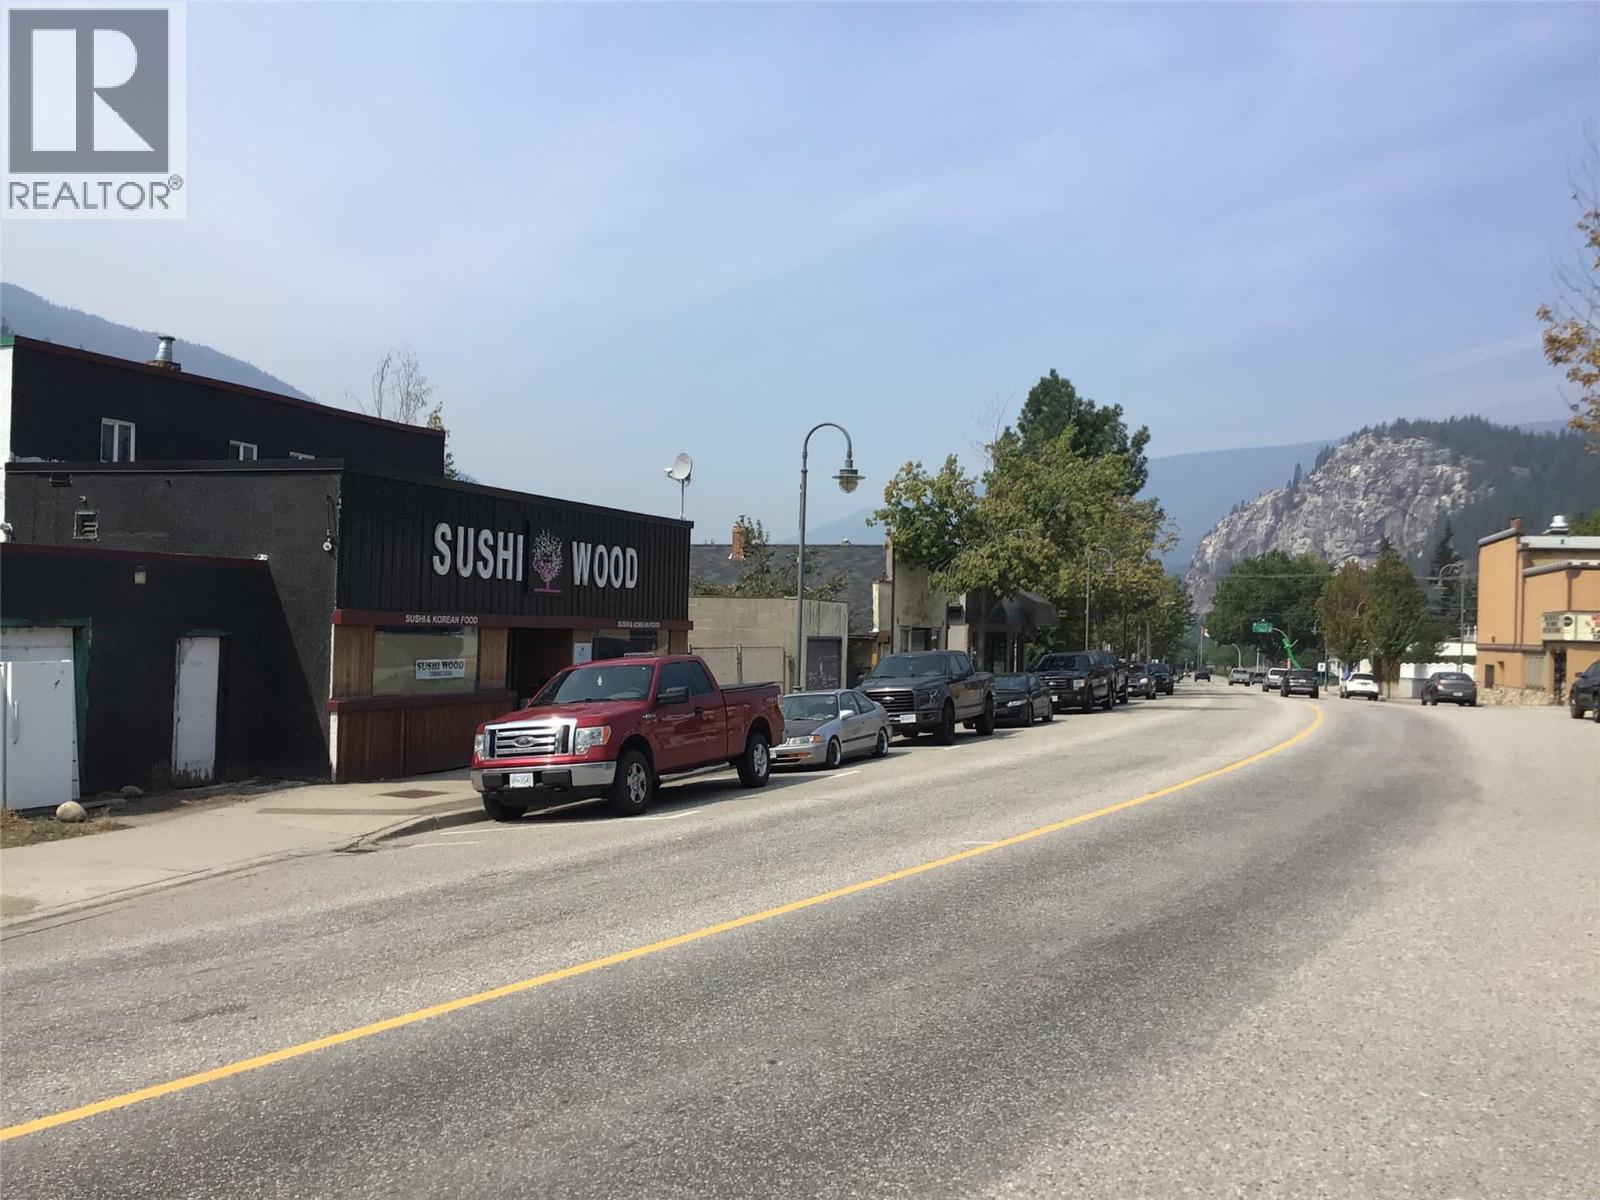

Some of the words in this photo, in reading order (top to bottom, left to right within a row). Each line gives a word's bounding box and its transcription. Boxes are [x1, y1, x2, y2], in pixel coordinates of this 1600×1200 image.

[432, 522, 524, 582] SUSHI
[571, 541, 638, 589] WOOD
[432, 615, 460, 624] KOREAN
[460, 616, 479, 624] FOOD
[417, 661, 441, 671] SUSHI
[441, 661, 465, 670] WOOD
